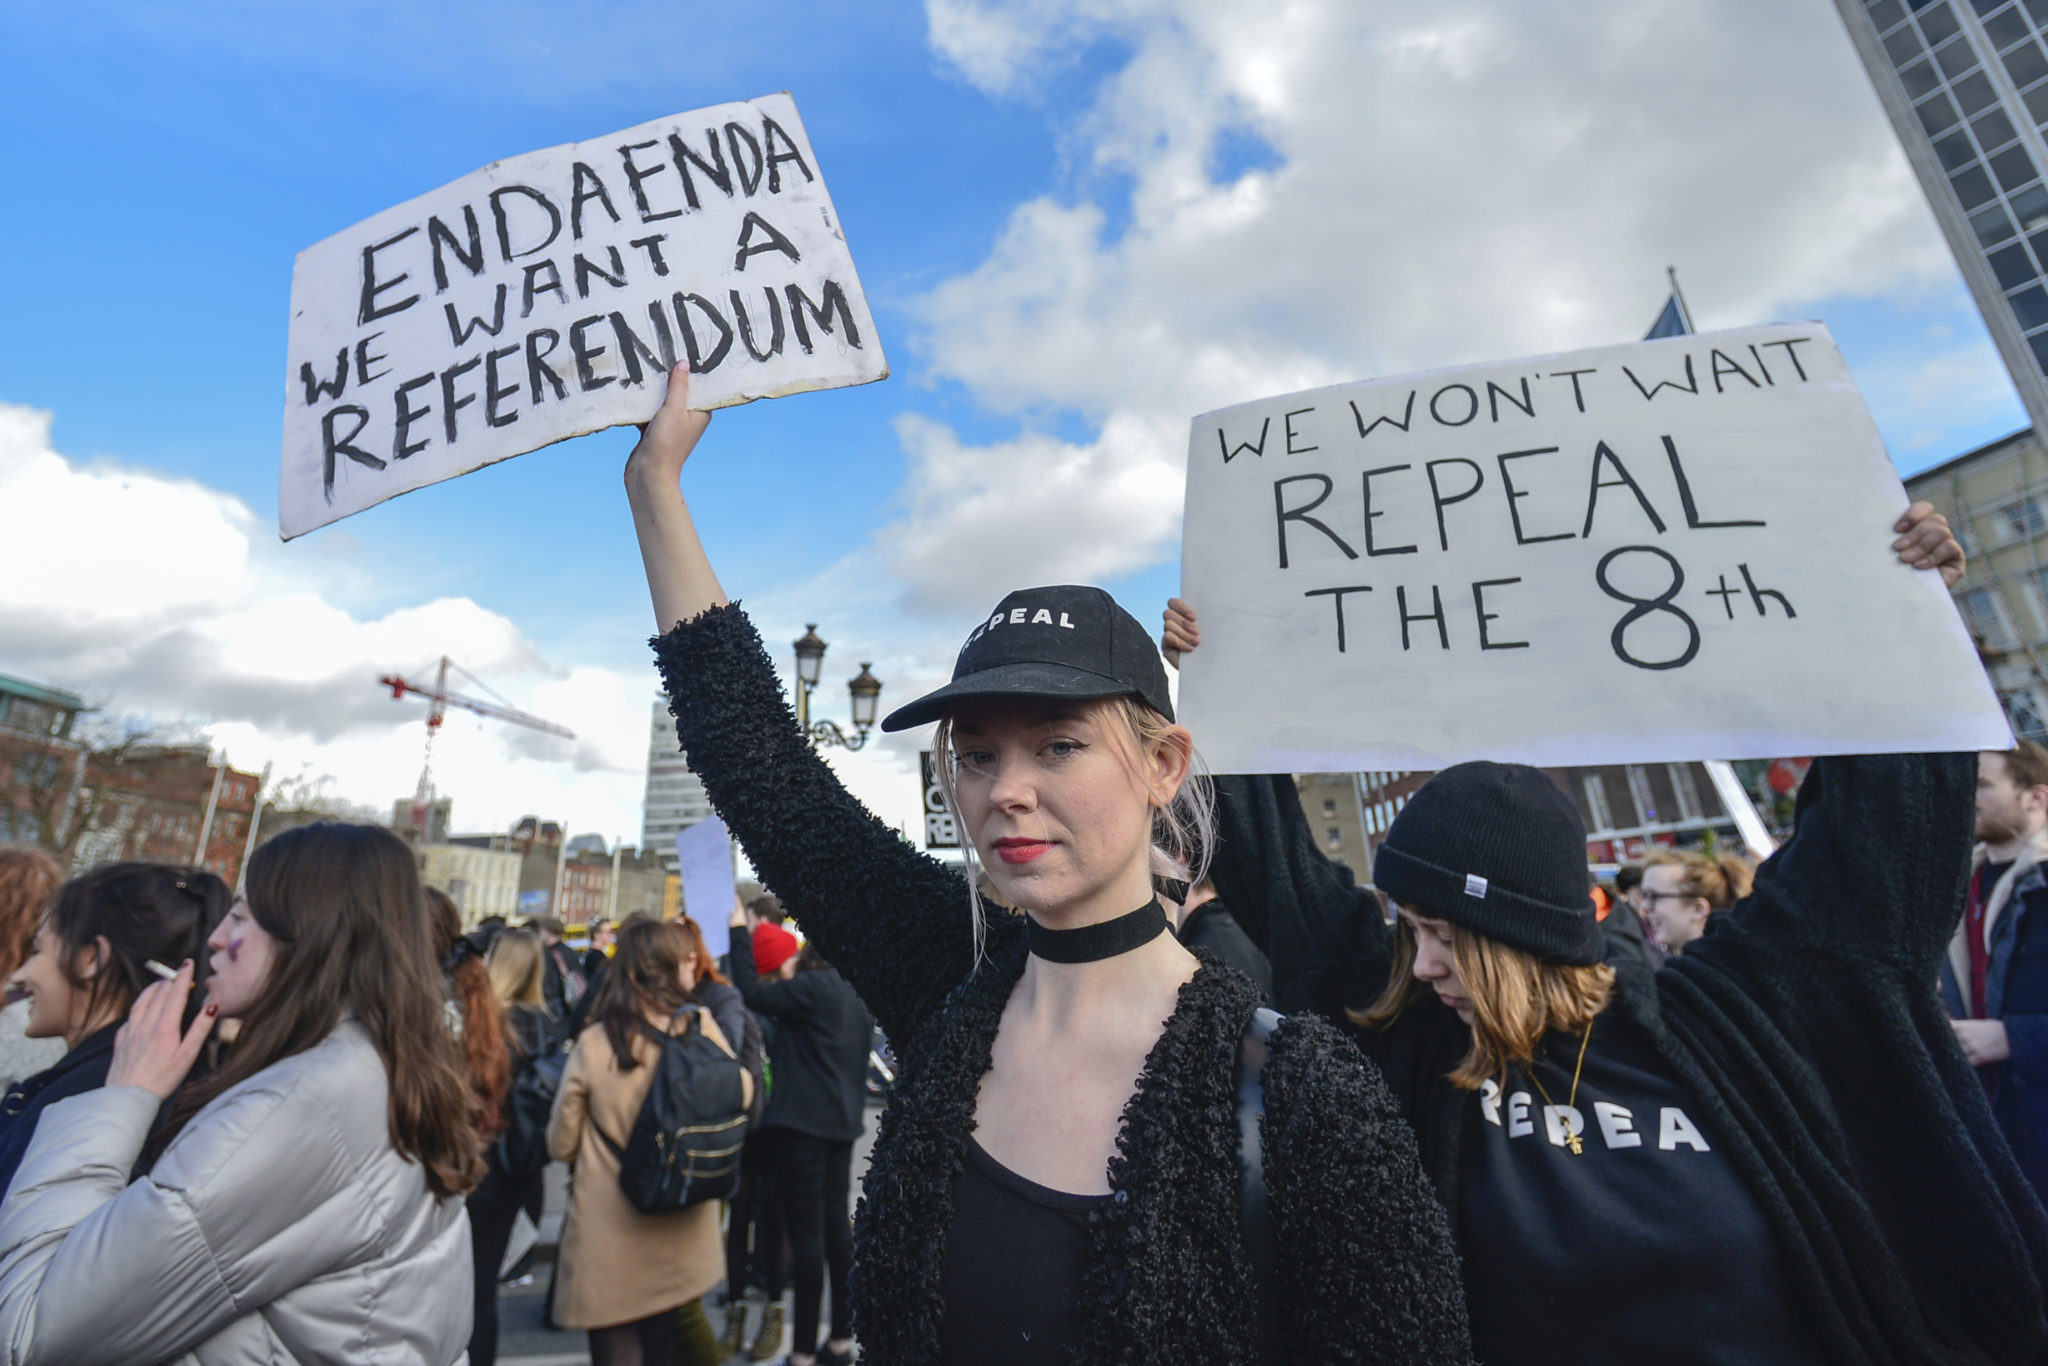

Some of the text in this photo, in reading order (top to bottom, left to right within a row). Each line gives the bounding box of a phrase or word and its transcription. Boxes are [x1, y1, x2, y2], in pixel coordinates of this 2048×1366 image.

[300, 210, 801, 406] WE WANT A
[321, 279, 863, 506] REFERENDUM
[1217, 337, 1812, 464] WE WON'T WAIT
[1273, 434, 1767, 569] REPEAL
[1304, 544, 1798, 671] THE 8th
[1480, 1078, 1711, 1152] REPEA
